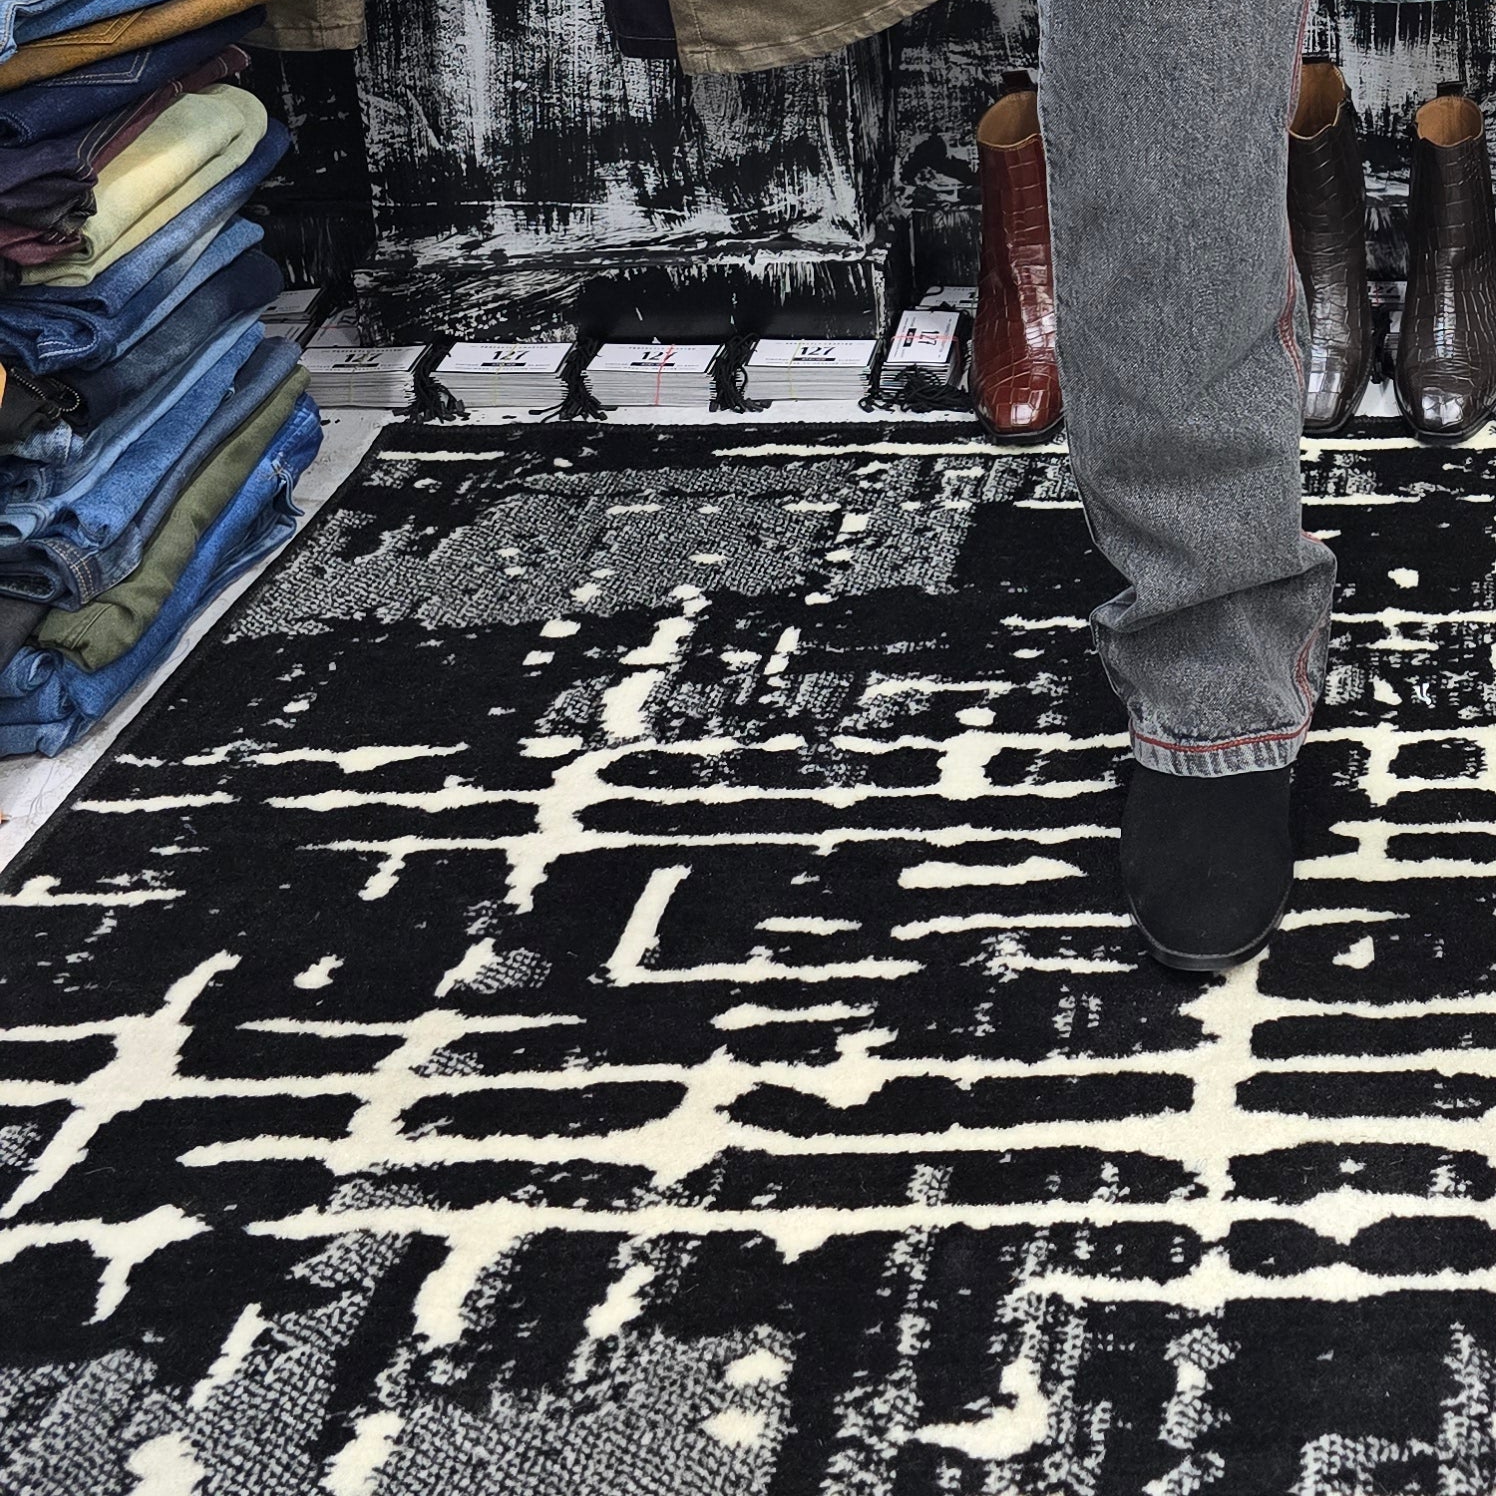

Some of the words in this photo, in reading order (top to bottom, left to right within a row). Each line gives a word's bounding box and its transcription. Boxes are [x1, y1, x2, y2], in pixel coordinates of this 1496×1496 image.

[918, 330, 940, 346] 127
[492, 350, 531, 360] 127
[800, 346, 836, 356] 127
